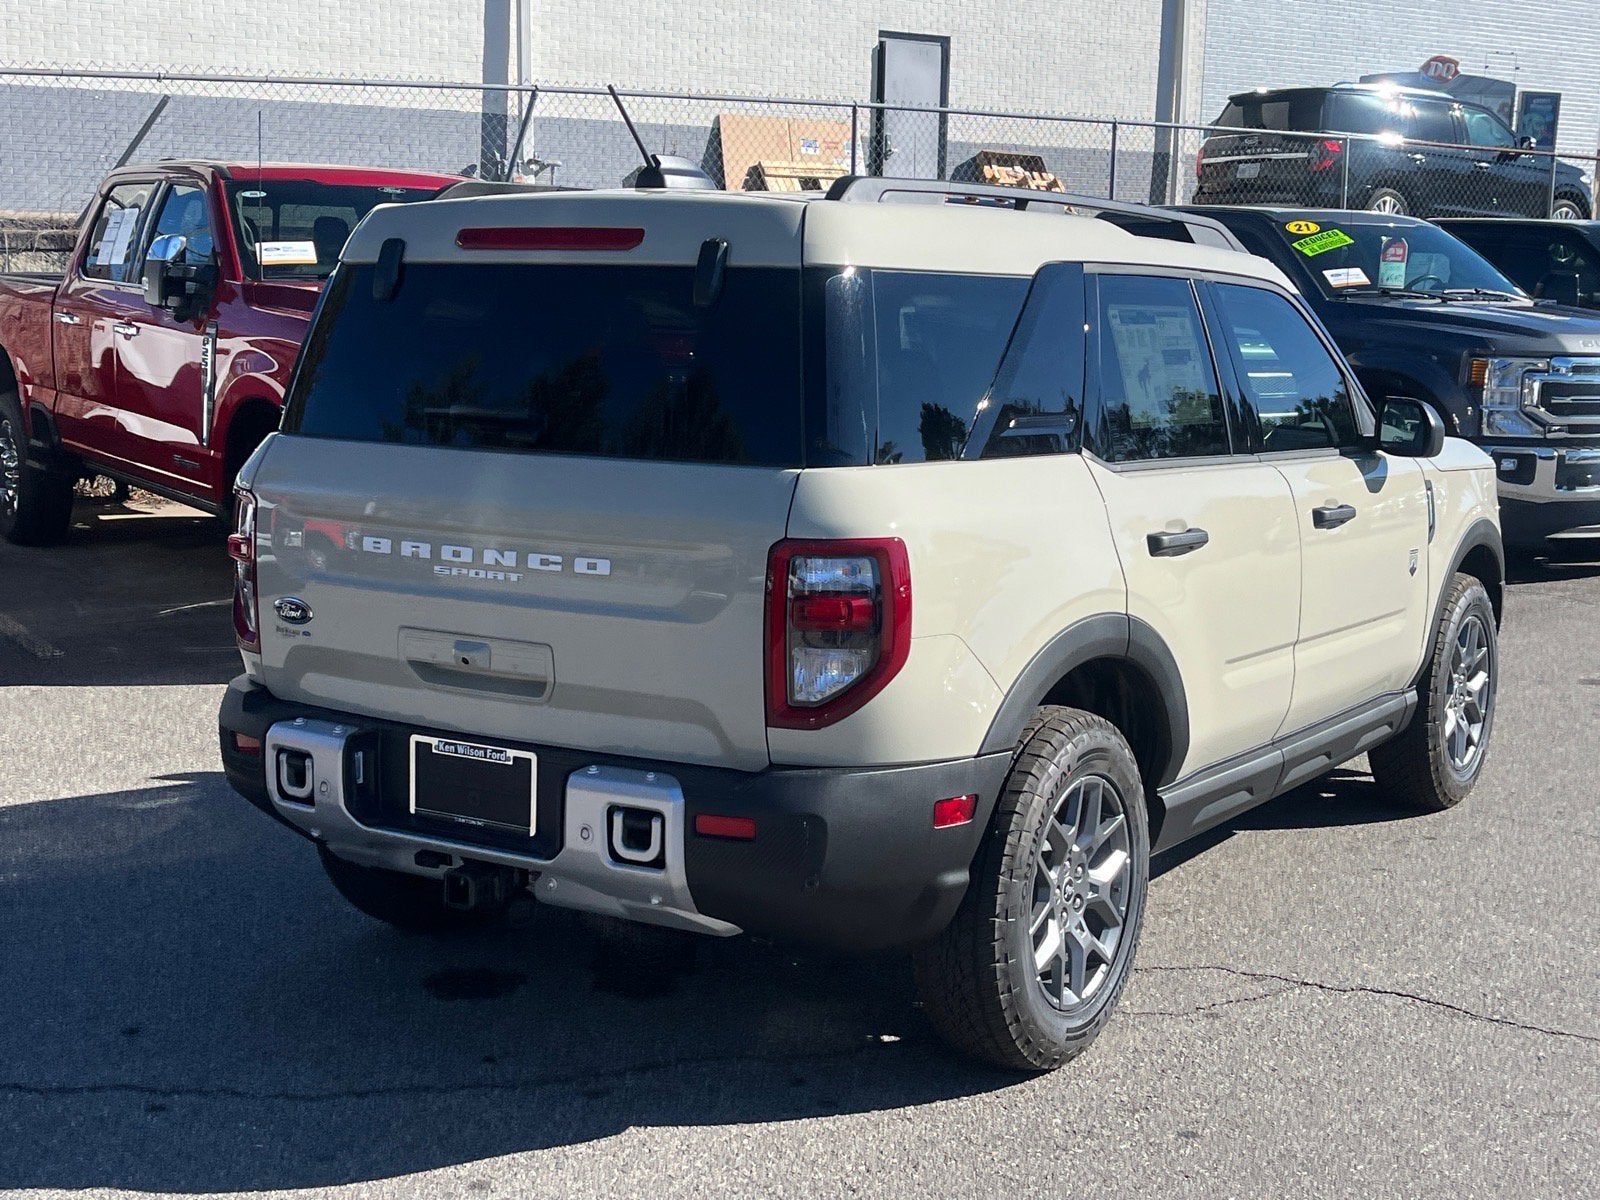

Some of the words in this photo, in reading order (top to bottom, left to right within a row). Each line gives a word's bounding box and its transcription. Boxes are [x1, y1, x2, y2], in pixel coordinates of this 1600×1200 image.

[1429, 61, 1455, 79] DQ
[1294, 223, 1311, 232] 21
[1297, 230, 1339, 248] REDUCED
[363, 536, 611, 576] BRONCO
[433, 565, 523, 582] SPORT
[438, 741, 455, 753] Ken
[457, 744, 485, 758] Wilson
[486, 748, 506, 761] Ford
